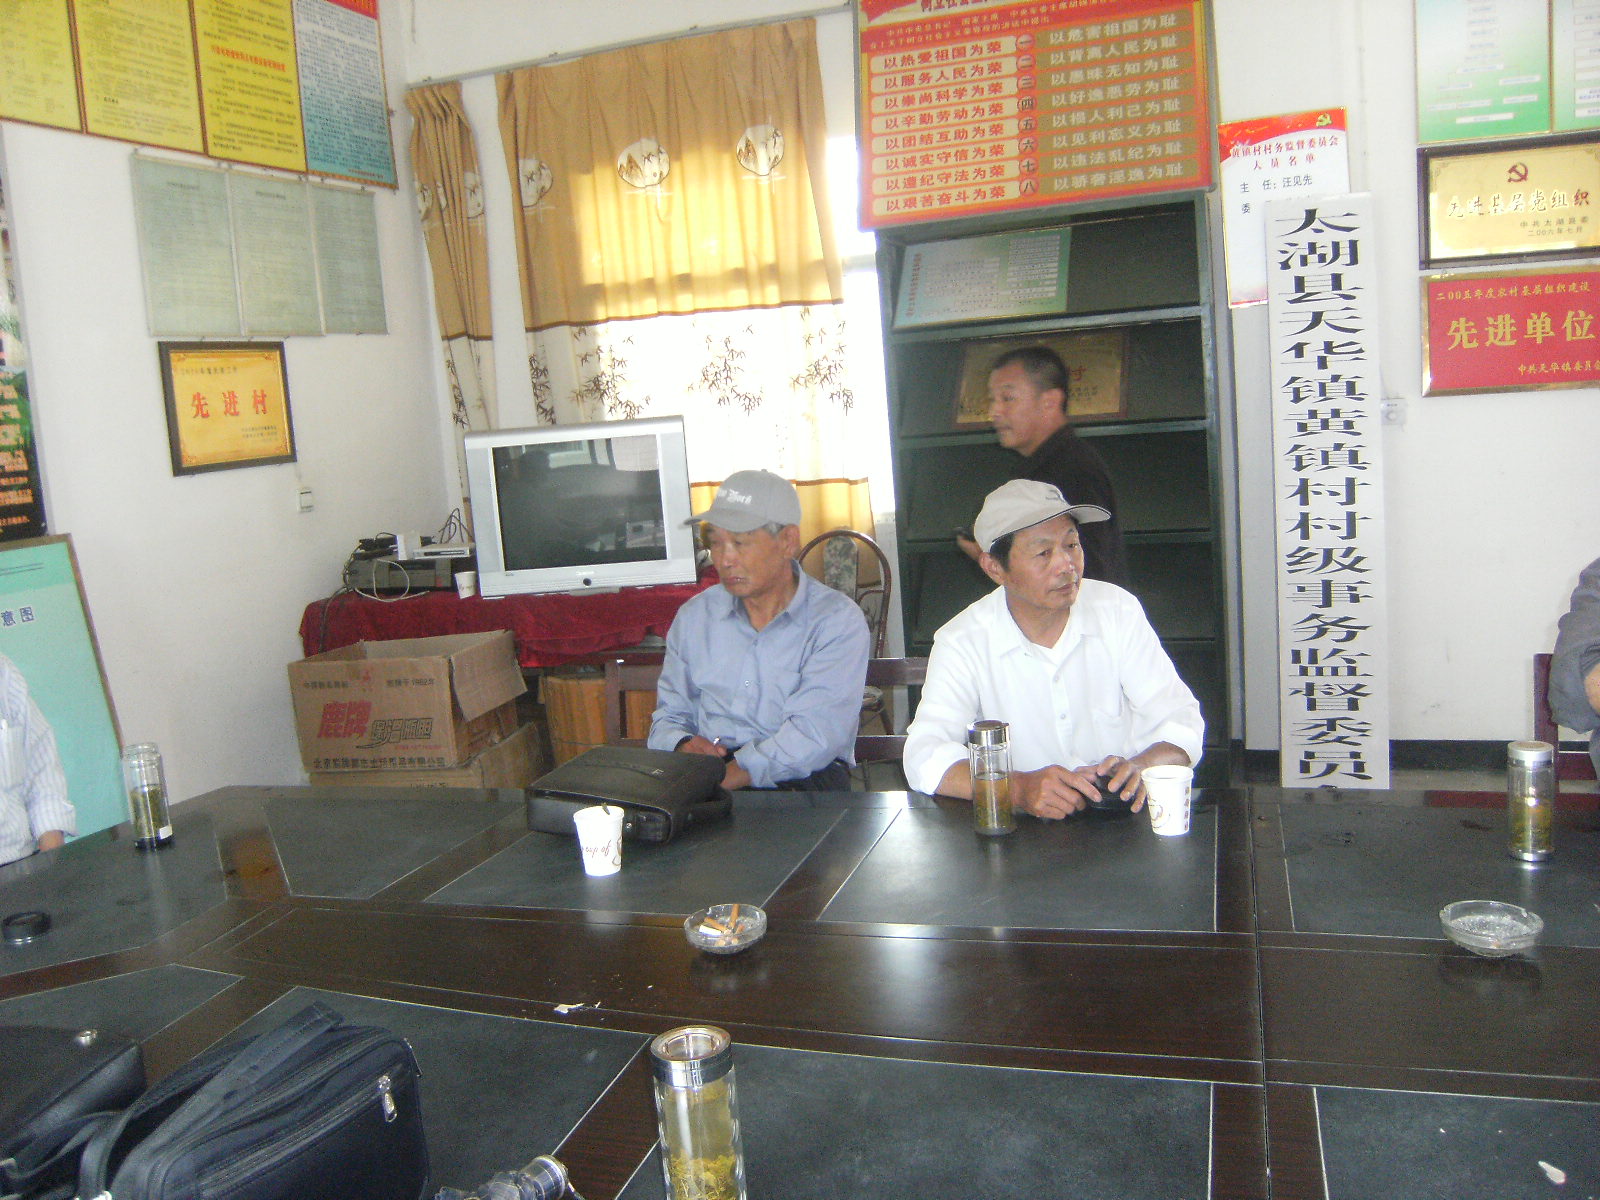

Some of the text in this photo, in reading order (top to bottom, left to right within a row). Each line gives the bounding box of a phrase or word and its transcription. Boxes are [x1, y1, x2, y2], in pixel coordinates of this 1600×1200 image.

[884, 41, 1001, 69] 以热爱祖国为荣
[1050, 14, 1177, 44] 以危害祖国为耻
[884, 34, 1177, 88] 以服务人民为荣 二 以背离人民为耻
[885, 55, 1179, 109] 以崇尚科学为荣 三 以愚昧无知为耻
[885, 76, 1180, 129] 以辛勤劳动为荣 四 以好逸恶劳为耻
[886, 99, 1181, 149] 以团结互助为荣 五 以损人利己为耻
[886, 119, 1182, 170] 以诚实守信为荣 六 以见利忘义为耻
[886, 141, 1183, 191] 以遵纪守法为荣 七 以违法乱纪为耻
[887, 162, 1184, 211] 以艰苦奋斗为荣 八 以骄奢淫逸为耻
[1253, 153, 1315, 170] 人员名单
[1448, 188, 1590, 218] 先进基层党组织
[1447, 309, 1596, 350] 先进单位
[191, 389, 268, 419] 先进村
[1275, 208, 1373, 788] 太湖县天华镇黄镇村村级事务监督委员
[1, 606, 35, 626] 意图
